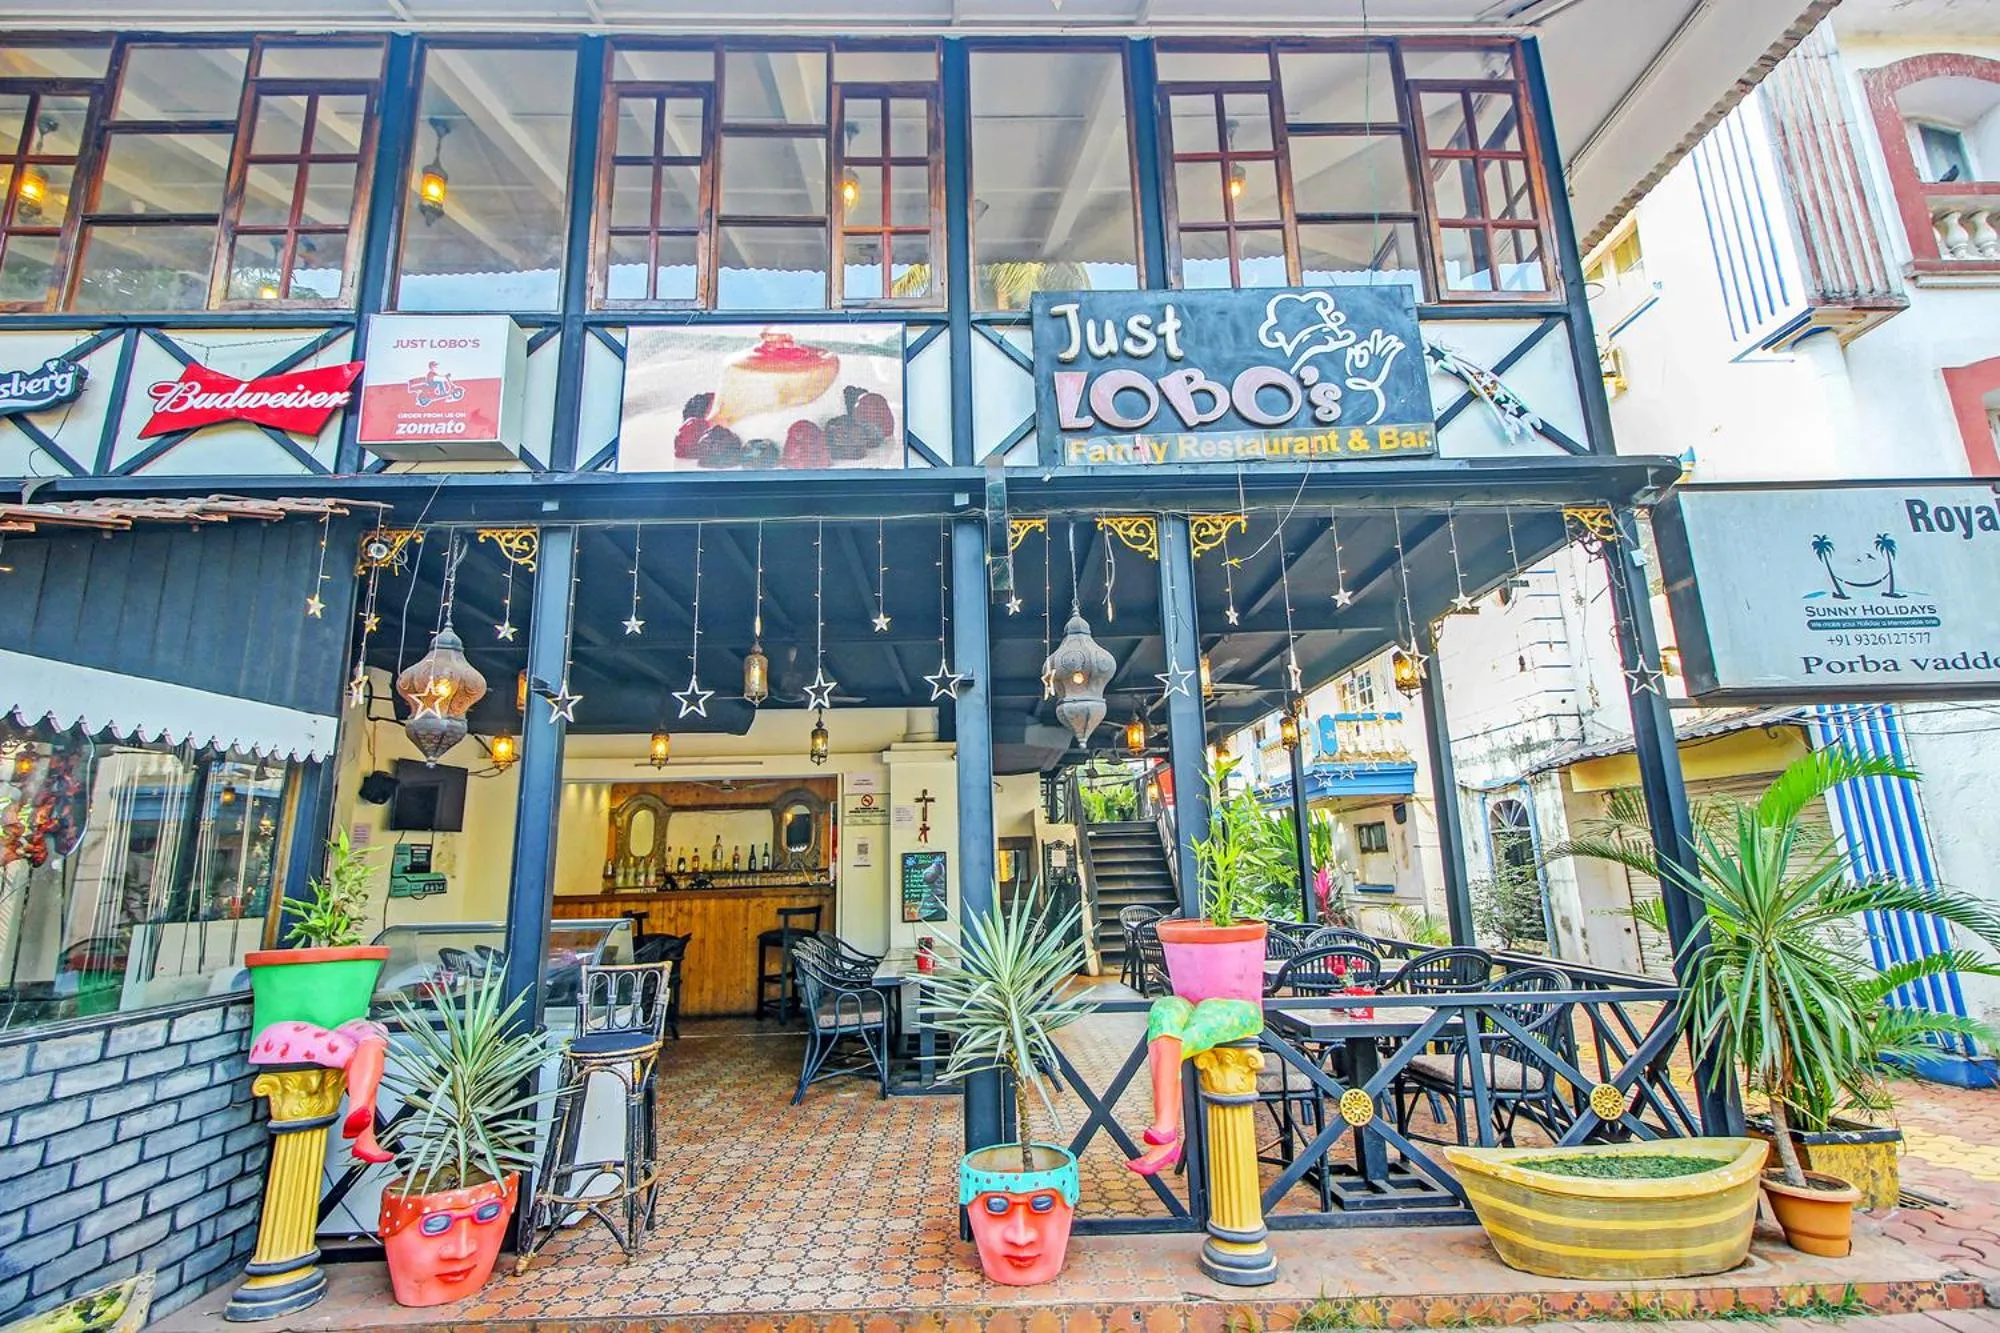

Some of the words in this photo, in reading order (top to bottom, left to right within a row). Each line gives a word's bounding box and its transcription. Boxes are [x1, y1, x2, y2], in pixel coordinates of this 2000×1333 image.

[1050, 303, 1185, 363] Just
[393, 339, 427, 348] JUST
[430, 339, 481, 348] LOBO'S
[148, 381, 351, 412] Budweiser
[1054, 365, 1342, 429] LOBO's
[396, 420, 466, 435] zomato
[1178, 430, 1337, 459] Restaurant
[1346, 429, 1370, 449] &
[1805, 605, 1858, 617] SUNNY
[1861, 604, 1937, 616] HOLIDAYS
[1827, 633, 1851, 646] +91
[1854, 632, 1931, 646] 9326127577
[1801, 655, 1901, 675] Porba
